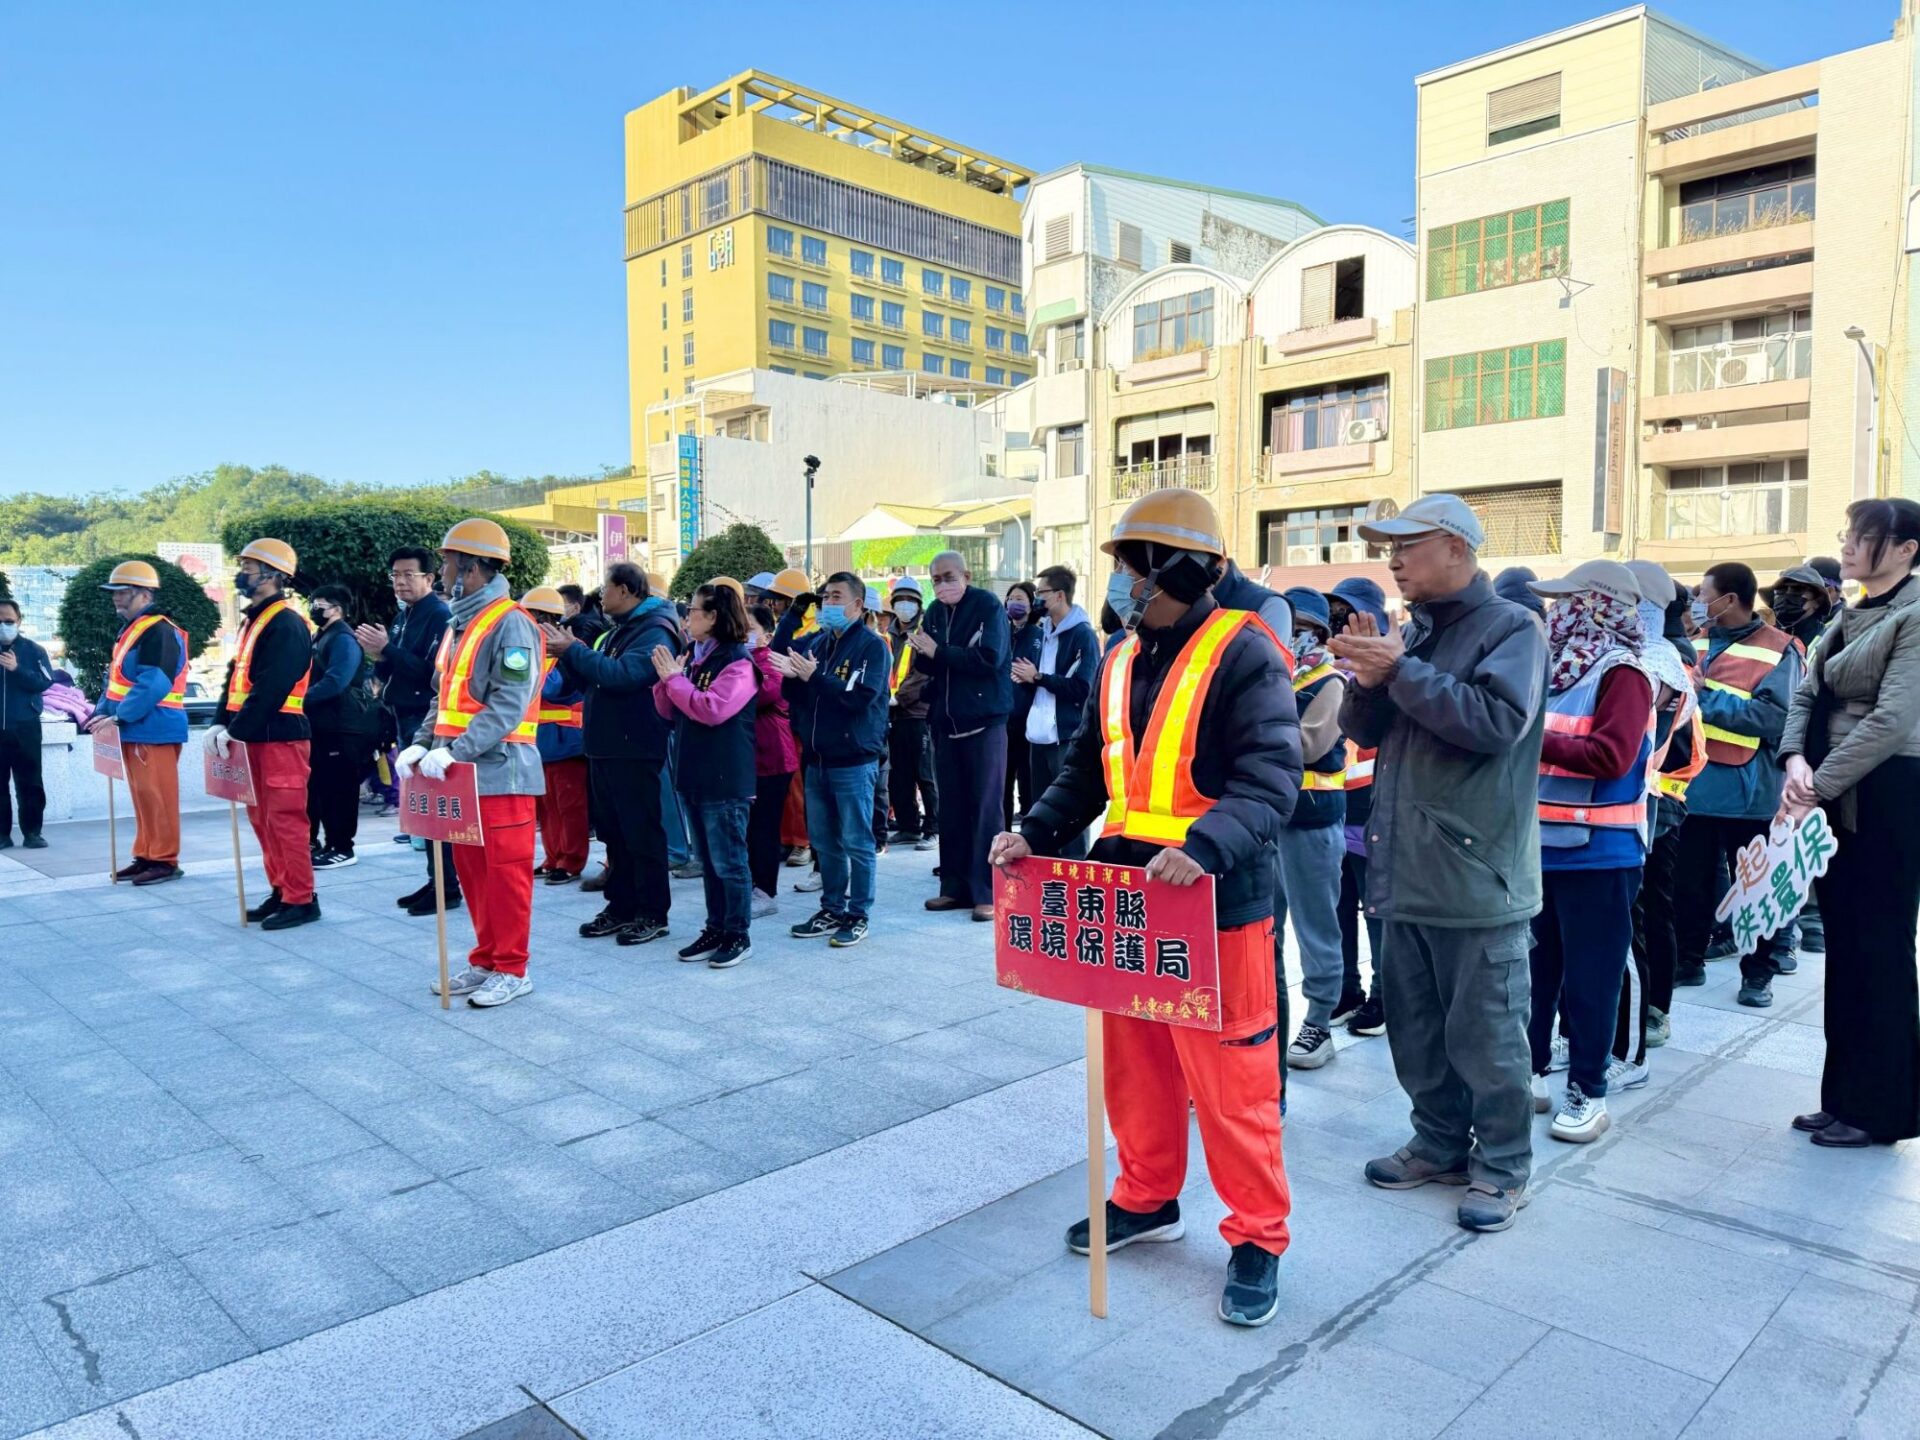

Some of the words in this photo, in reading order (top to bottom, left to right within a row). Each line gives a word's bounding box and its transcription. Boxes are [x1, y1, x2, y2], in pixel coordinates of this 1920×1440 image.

[1040, 880, 1147, 930] 臺東縣
[1008, 914, 1191, 981] 環境保護局
